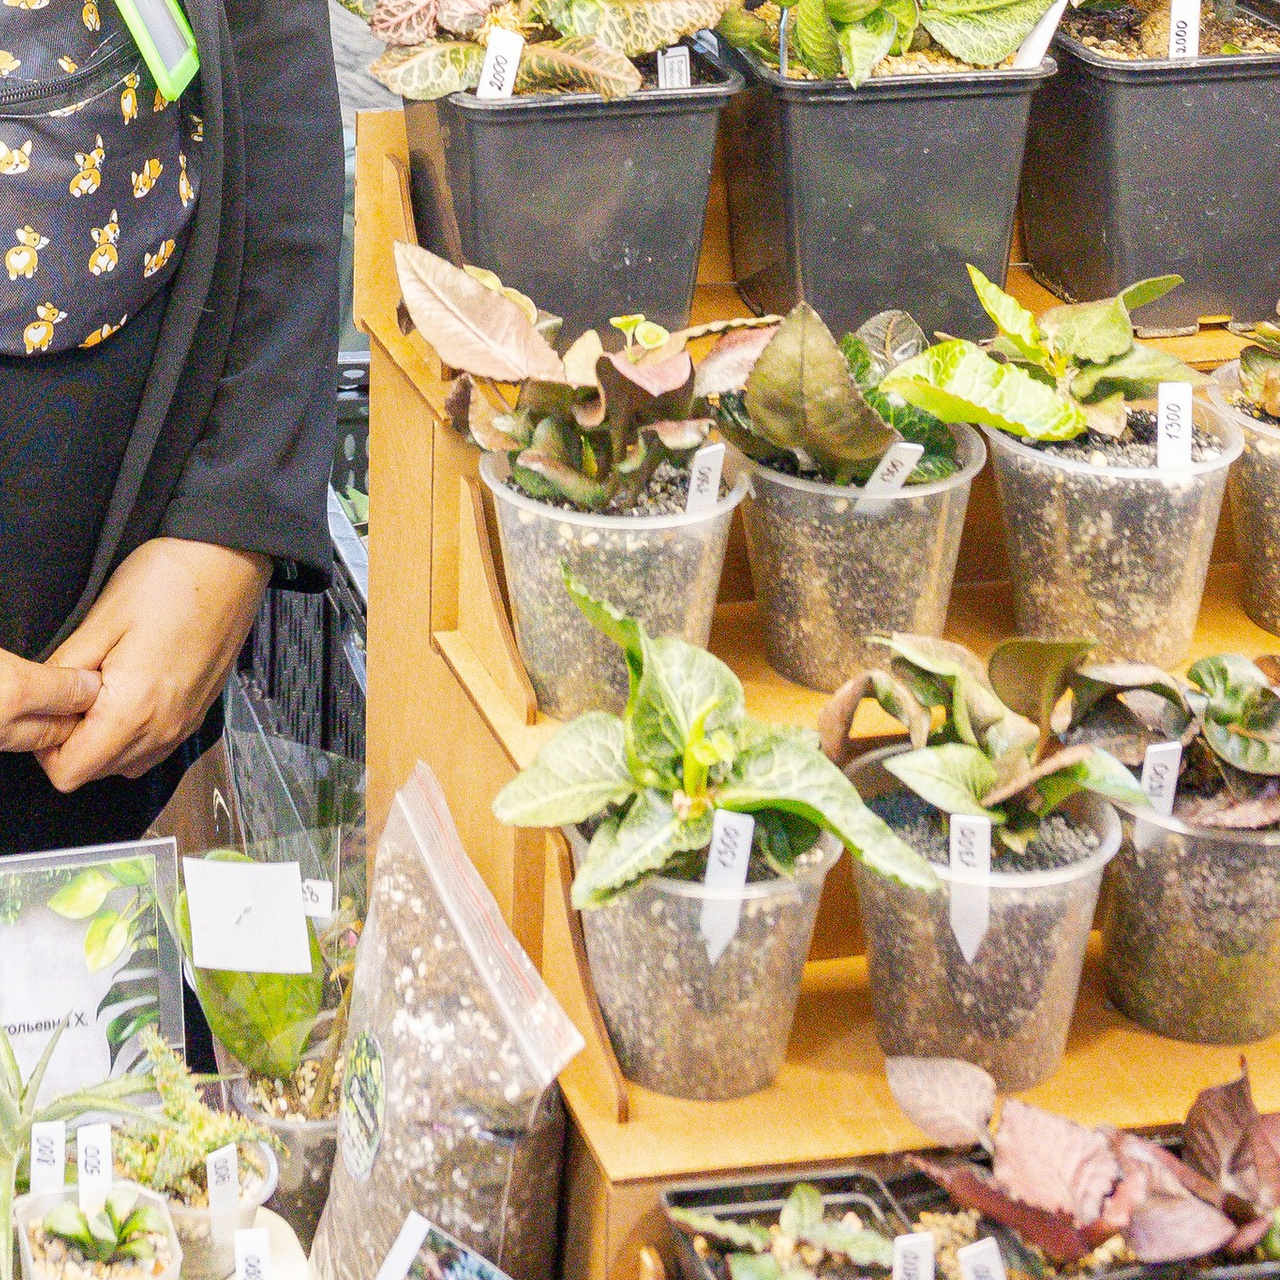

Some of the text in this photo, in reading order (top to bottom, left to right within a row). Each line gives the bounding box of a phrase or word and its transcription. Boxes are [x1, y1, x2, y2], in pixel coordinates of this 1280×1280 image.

[1175, 19, 1189, 54] 2000
[488, 54, 509, 91] 2000
[1164, 402, 1182, 440] 1300
